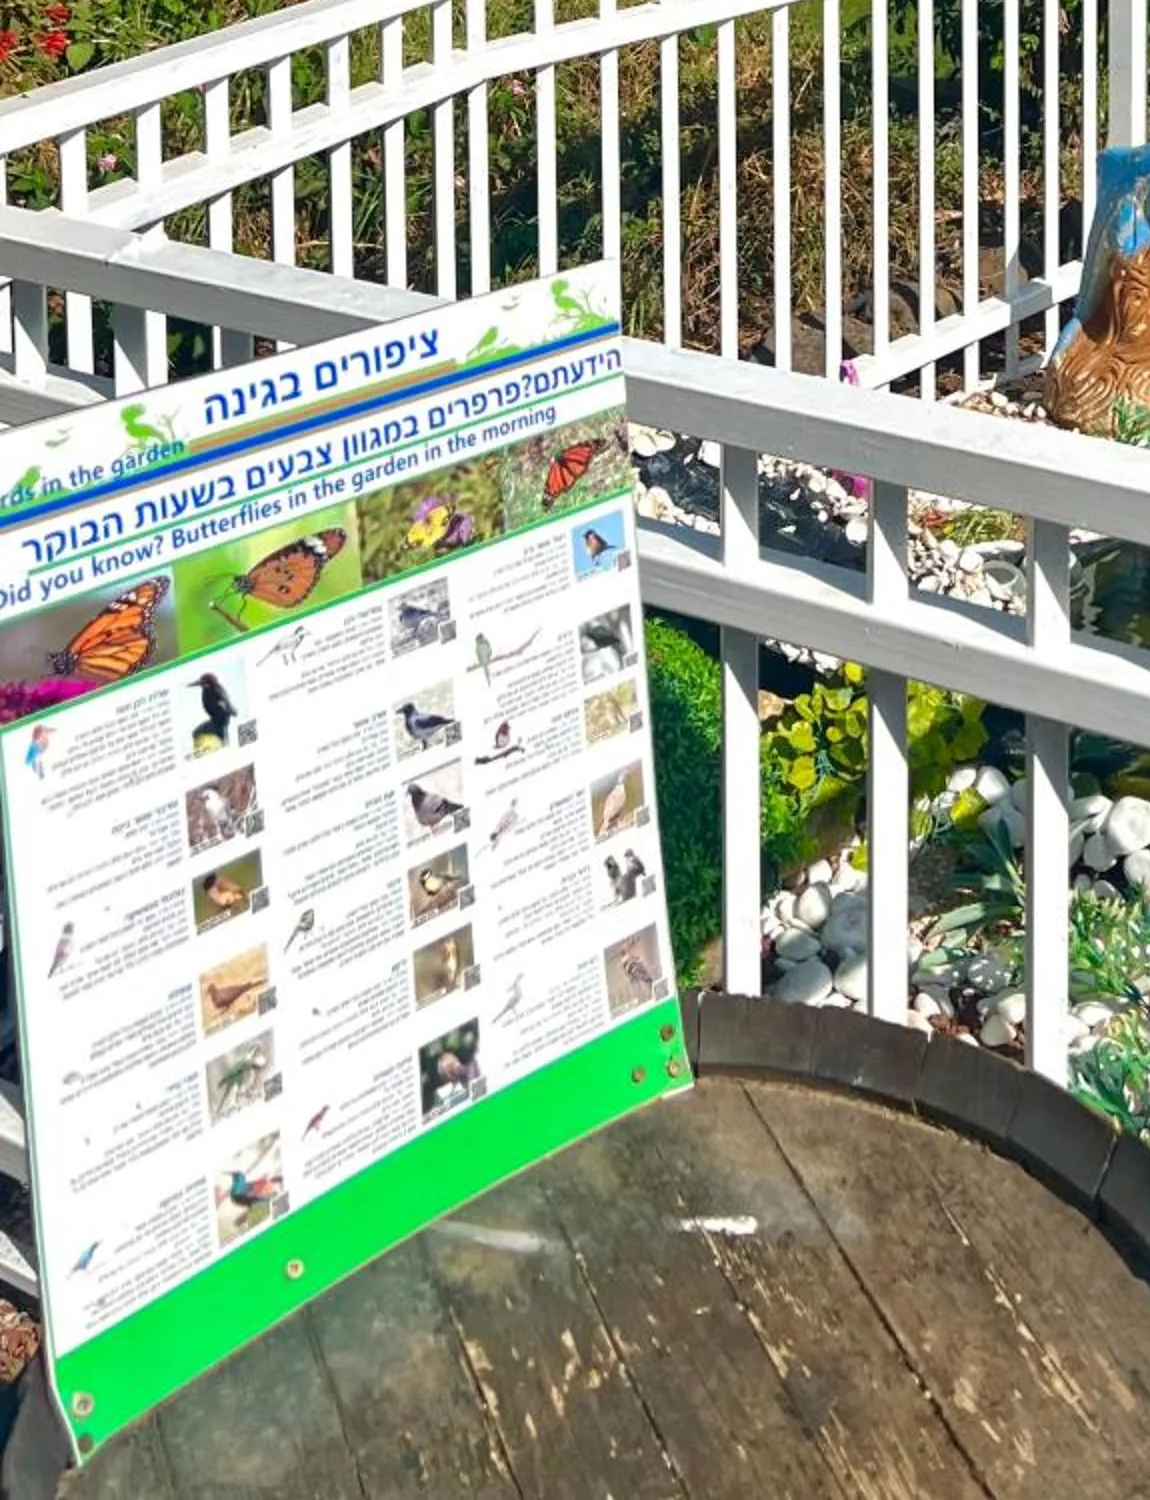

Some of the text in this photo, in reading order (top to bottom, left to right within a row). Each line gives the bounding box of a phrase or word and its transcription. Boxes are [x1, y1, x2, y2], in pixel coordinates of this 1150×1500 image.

[203, 328, 439, 425] ציפורים בגינה
[343, 415, 419, 462] במגוון
[42, 476, 62, 496] in
[69, 465, 104, 487] the
[111, 440, 185, 476] garden
[246, 442, 332, 491] צבעים
[40, 567, 83, 601] you
[91, 535, 164, 577] know?
[172, 501, 282, 549] Butterflies
[288, 490, 307, 510] in
[313, 475, 345, 501] the
[351, 453, 418, 493] garden
[424, 443, 441, 463] in
[447, 428, 477, 452] the
[482, 405, 556, 443] morning
[135, 475, 235, 529] בשעות
[21, 512, 123, 562] הבוקר
